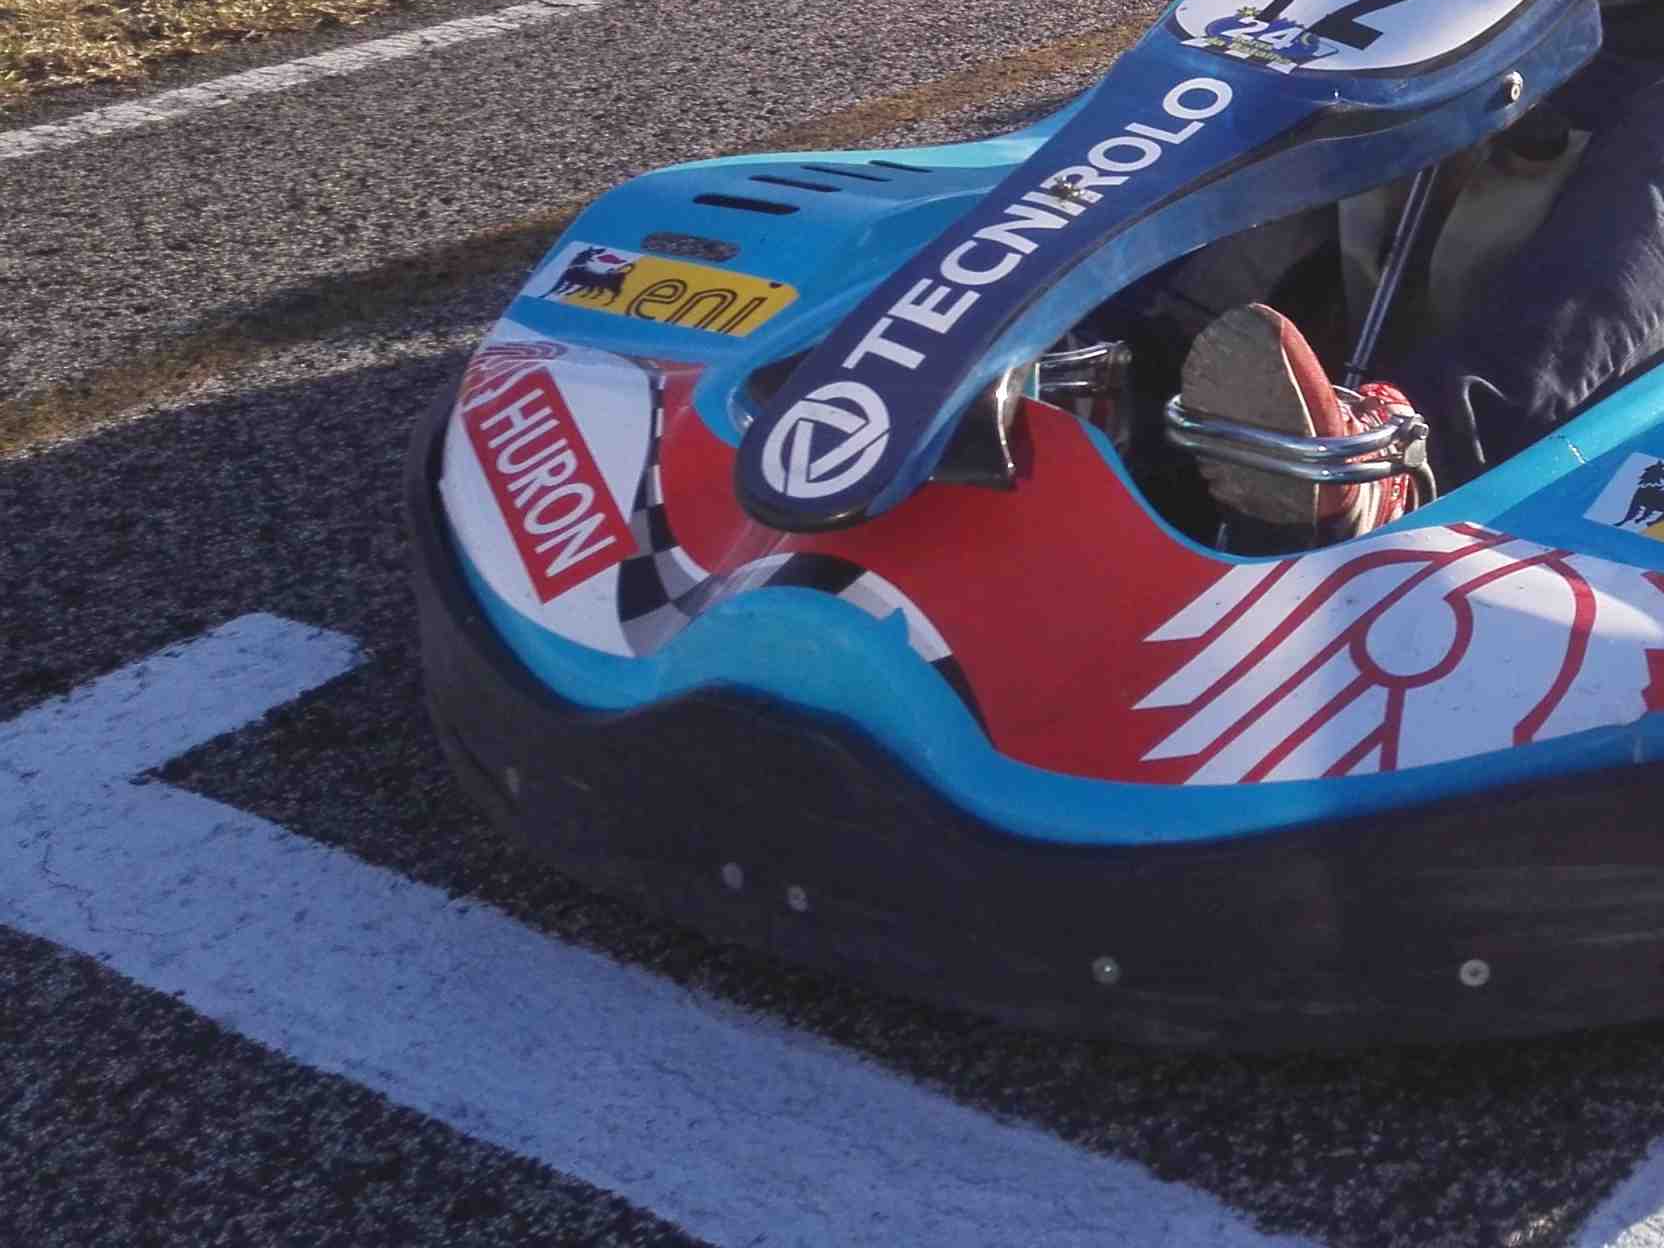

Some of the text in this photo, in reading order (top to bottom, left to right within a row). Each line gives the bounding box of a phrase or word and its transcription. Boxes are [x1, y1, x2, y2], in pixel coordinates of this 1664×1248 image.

[1220, 17, 1304, 50] 24
[841, 77, 1234, 370] TECNIROLO
[626, 278, 784, 337] eni
[479, 386, 617, 578] HURON
